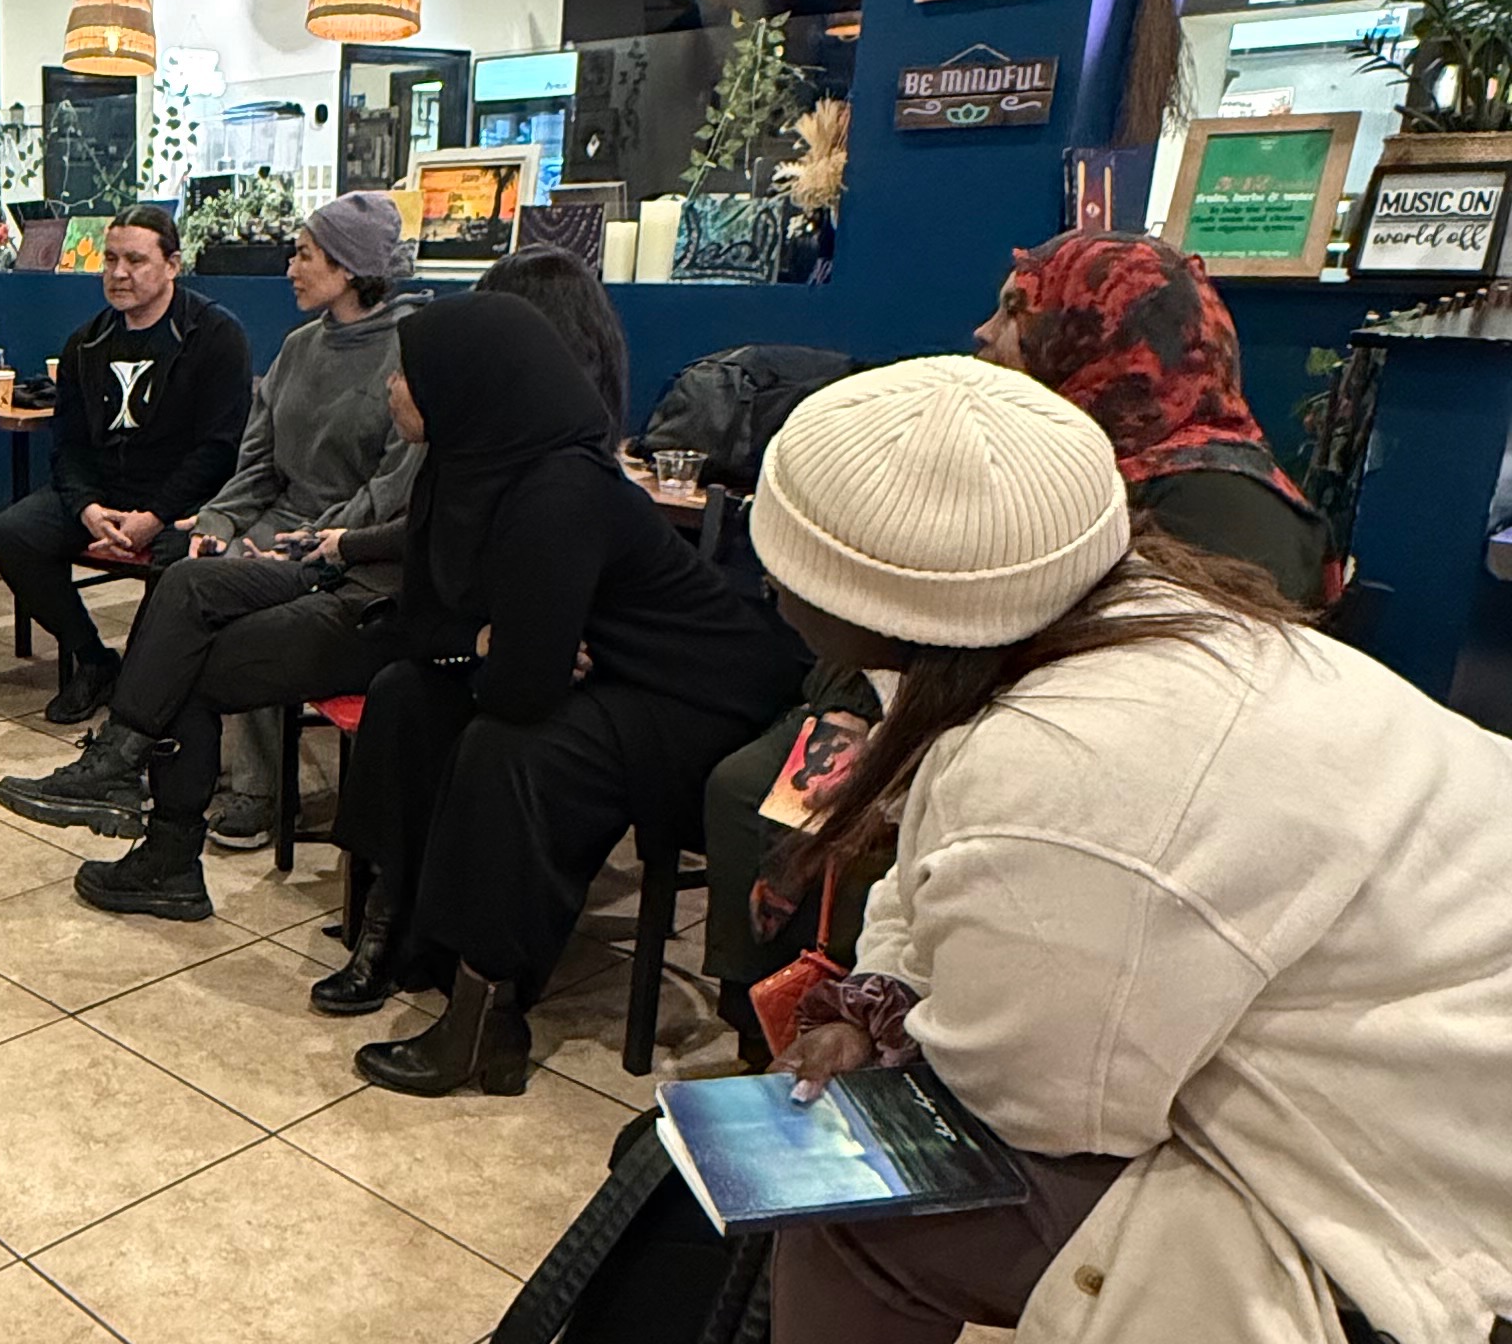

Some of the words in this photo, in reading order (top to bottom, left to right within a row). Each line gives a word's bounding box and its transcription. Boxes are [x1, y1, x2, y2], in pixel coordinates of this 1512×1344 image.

[904, 72, 934, 96] BE
[1378, 191, 1455, 214] MUSIC
[1458, 189, 1495, 213] ON
[1372, 223, 1447, 248] world
[1446, 223, 1488, 252] off
